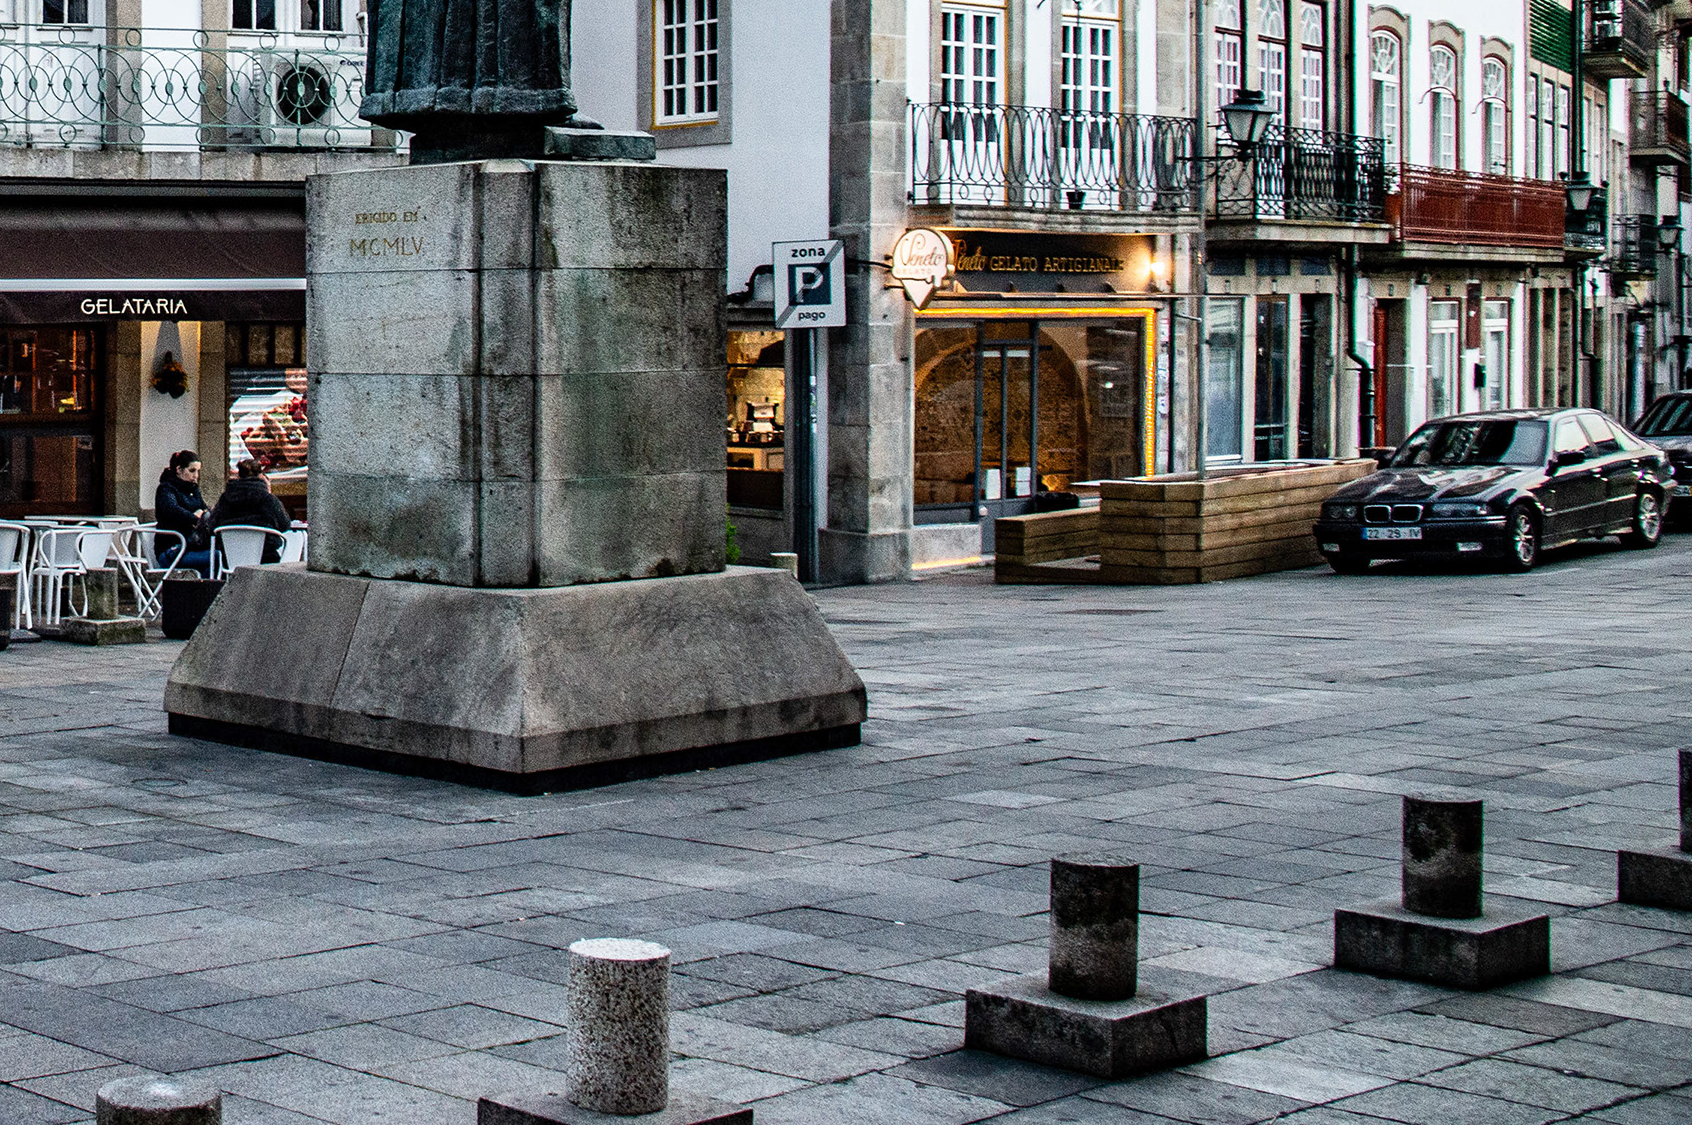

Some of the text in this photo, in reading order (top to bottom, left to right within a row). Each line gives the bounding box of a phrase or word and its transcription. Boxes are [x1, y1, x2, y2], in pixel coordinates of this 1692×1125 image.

[355, 211, 418, 225] ERIGIDO EM
[349, 236, 424, 257] MCMLV
[791, 246, 826, 258] zona
[900, 233, 945, 266] Veneto
[990, 256, 1039, 272] GELATO
[1043, 257, 1125, 273] ARTIGIANALE
[795, 266, 824, 303] P
[80, 298, 188, 315] GELATARIA
[798, 309, 826, 321] pago
